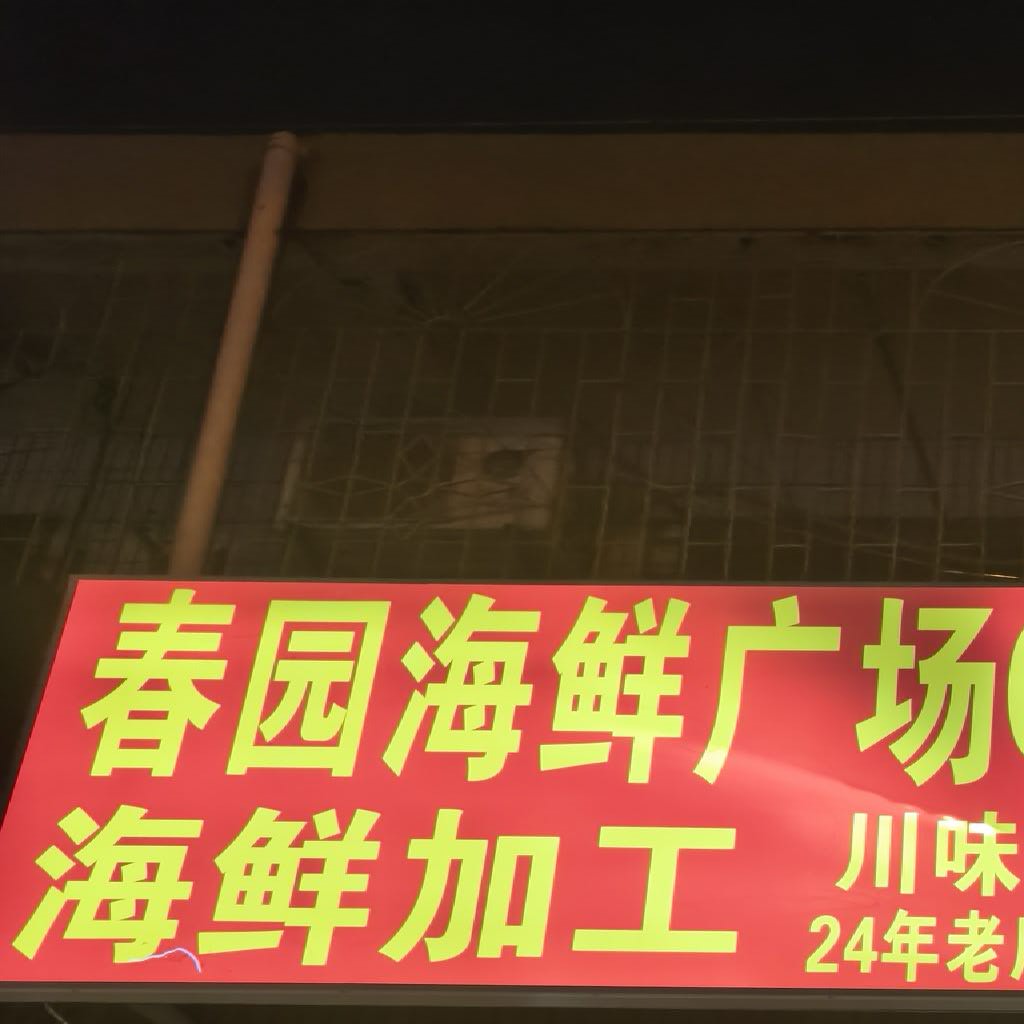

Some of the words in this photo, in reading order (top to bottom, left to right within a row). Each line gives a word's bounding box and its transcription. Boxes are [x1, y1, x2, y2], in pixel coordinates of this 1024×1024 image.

[12, 804, 737, 966] 海鲜加工
[836, 811, 1019, 896] 川味
